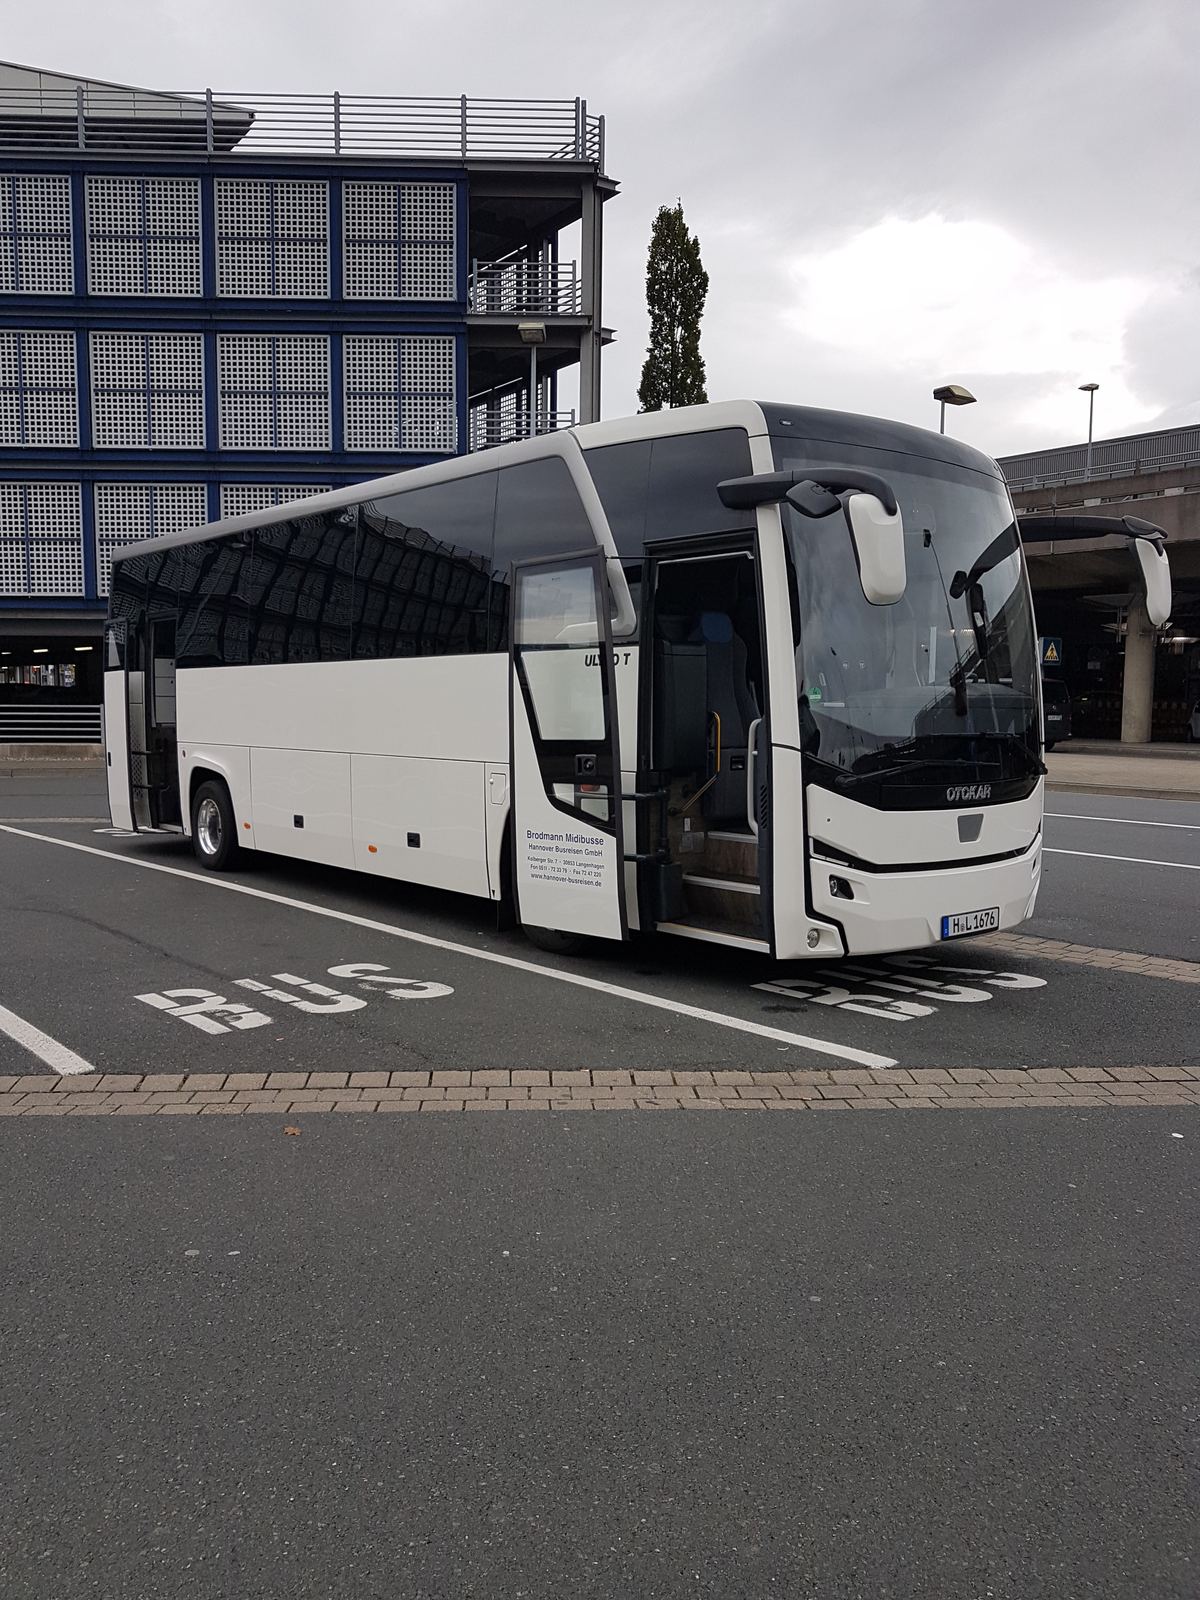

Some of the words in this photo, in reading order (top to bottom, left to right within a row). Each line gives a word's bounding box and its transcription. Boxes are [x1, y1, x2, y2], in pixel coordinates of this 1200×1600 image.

[623, 652, 631, 665] T
[946, 784, 991, 801] OTOKAR
[526, 829, 564, 842] Brodmann
[565, 833, 604, 846] Midibusse
[528, 842, 554, 852] Hannover
[555, 845, 583, 855] Busreisen
[584, 848, 603, 857] GmbH
[133, 963, 455, 1035] BUS
